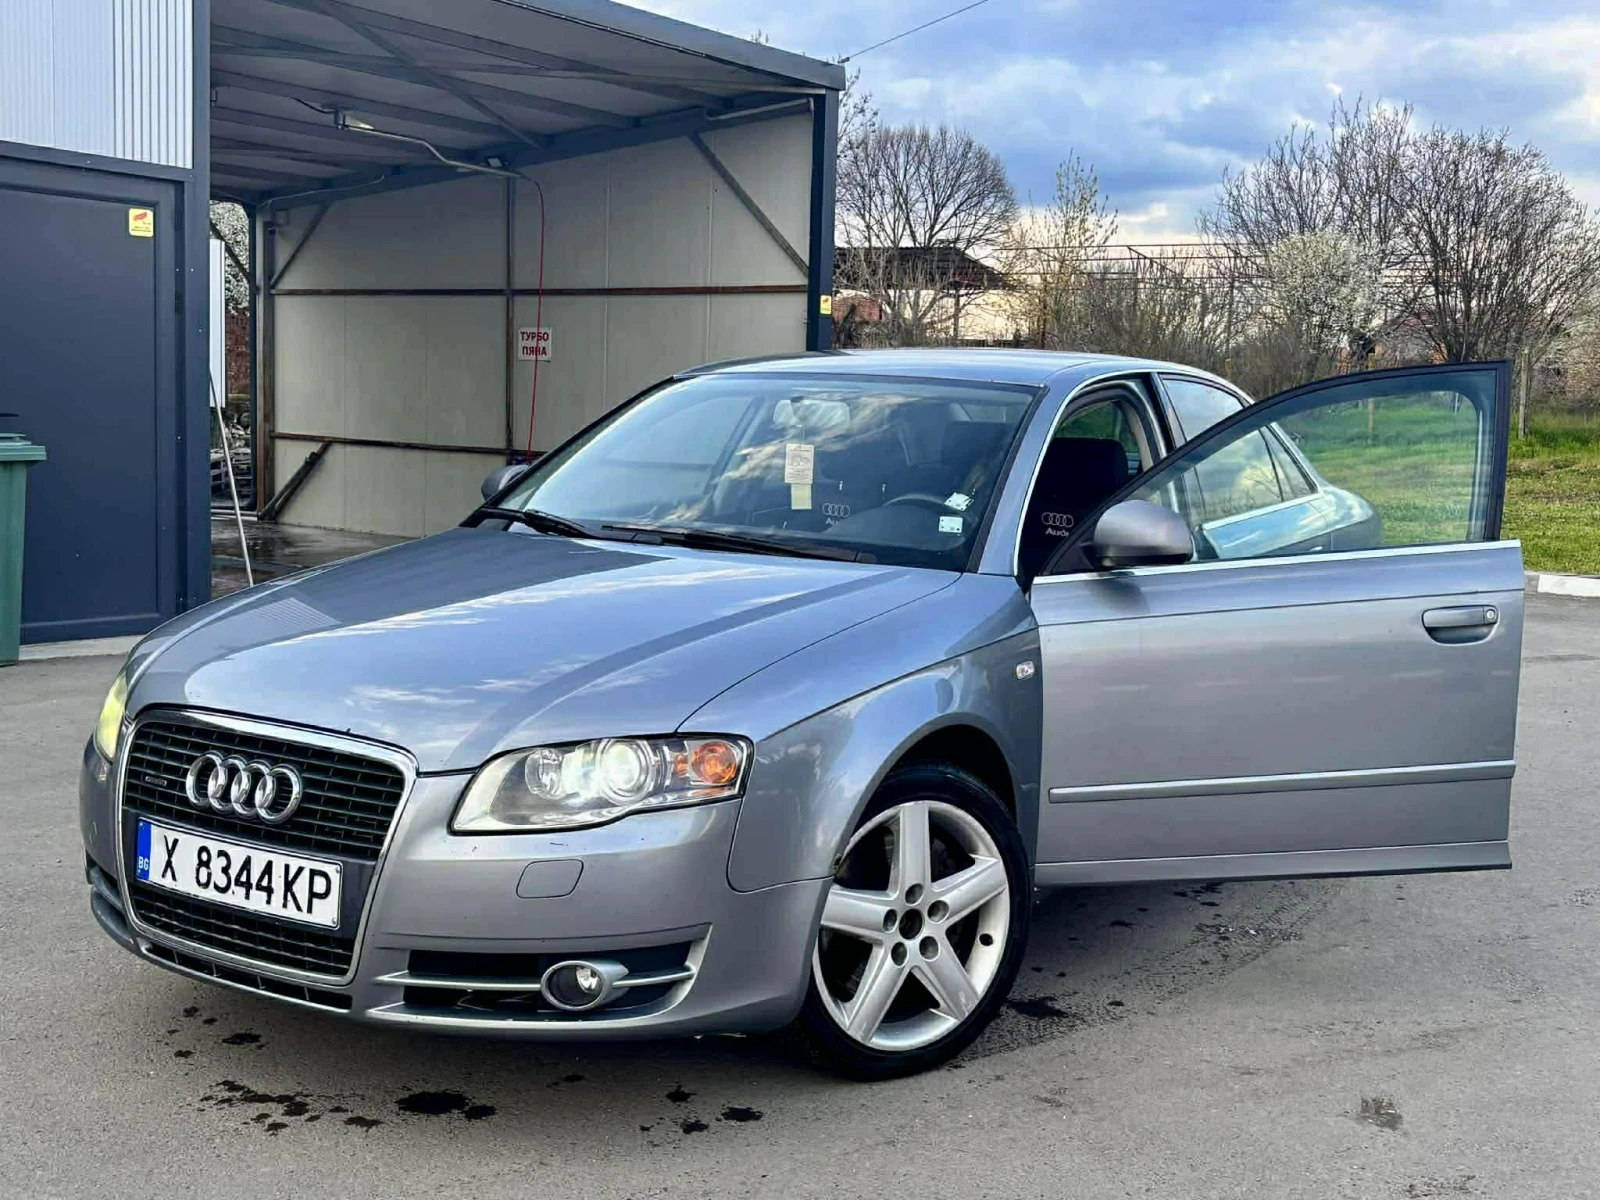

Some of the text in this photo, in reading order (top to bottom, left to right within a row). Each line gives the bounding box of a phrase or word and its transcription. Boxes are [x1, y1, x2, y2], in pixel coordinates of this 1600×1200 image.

[520, 331, 549, 341] ТУРБО
[522, 346, 547, 356] ПЯНА
[138, 855, 149, 871] BG
